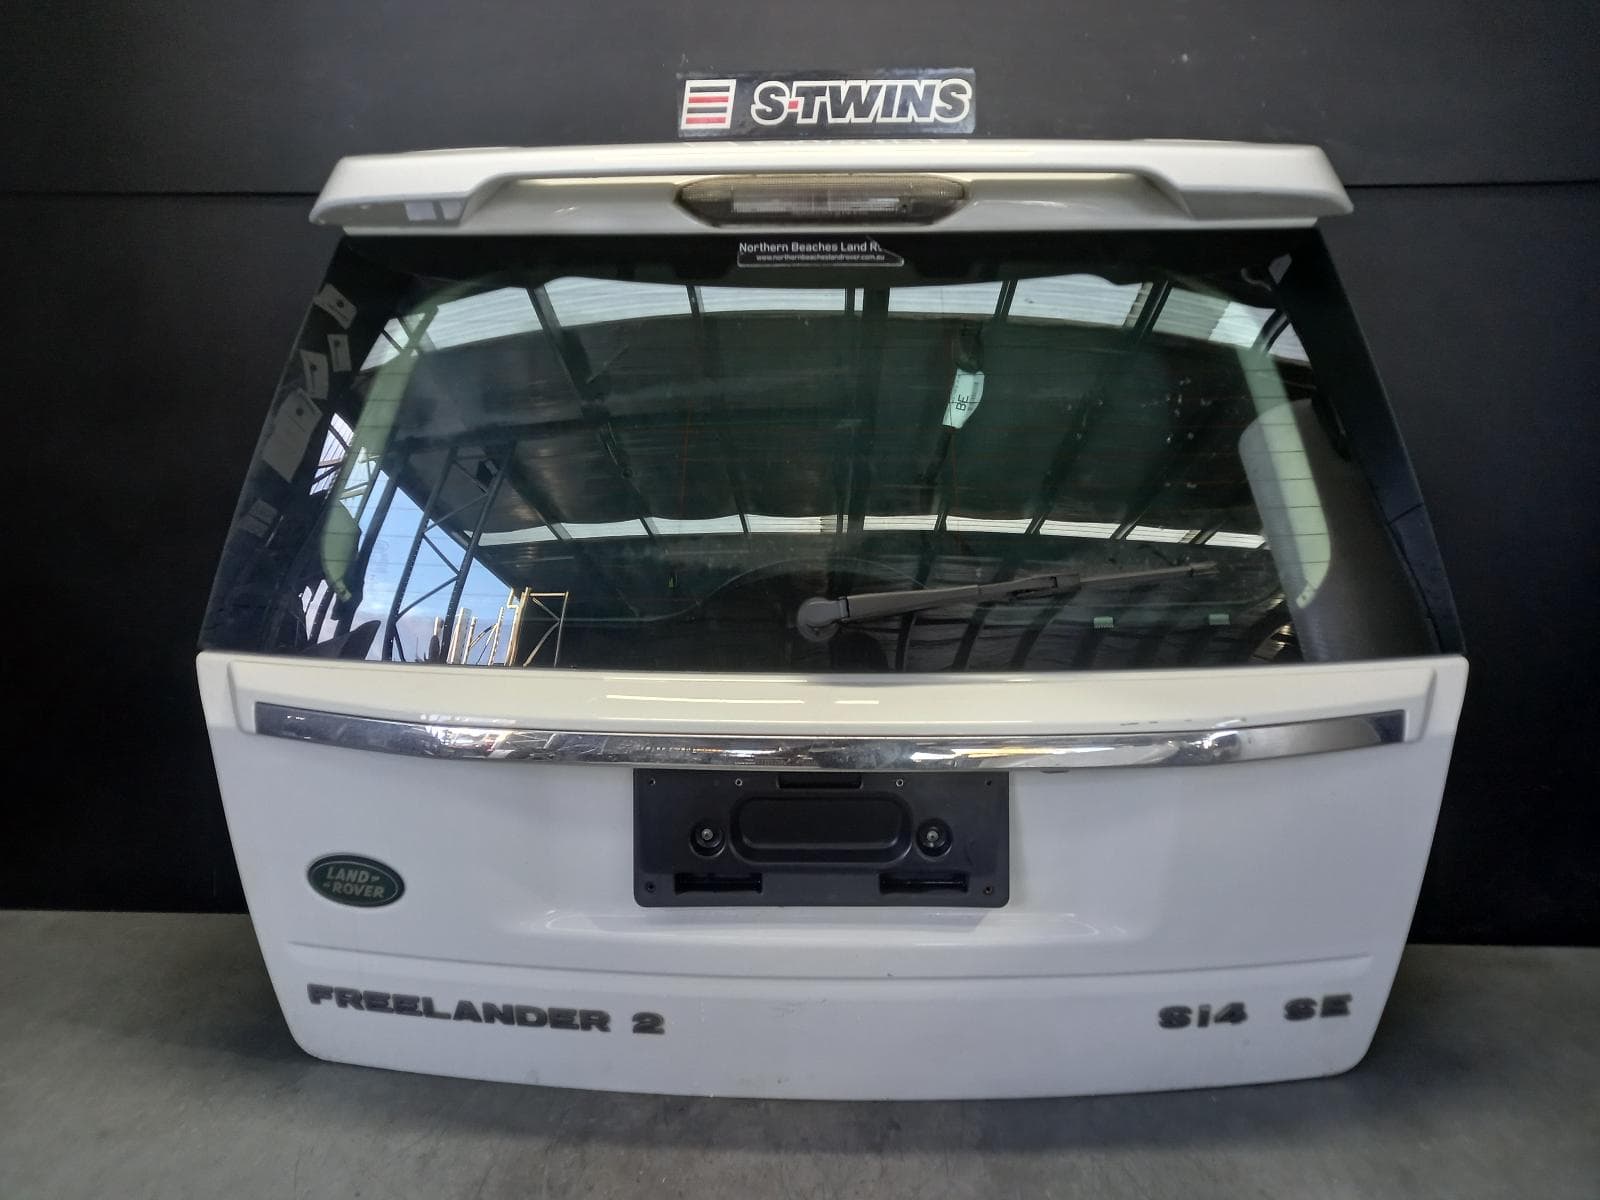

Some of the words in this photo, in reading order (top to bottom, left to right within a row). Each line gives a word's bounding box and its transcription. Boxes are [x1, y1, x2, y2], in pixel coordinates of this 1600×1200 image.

[739, 242, 789, 253] Northern
[791, 242, 837, 253] Beaches
[840, 242, 867, 253] Land
[307, 983, 611, 1033] FREELANDER
[631, 1011, 665, 1035] 2
[1158, 1001, 1248, 1030] Si4
[1283, 993, 1353, 1022] SE
